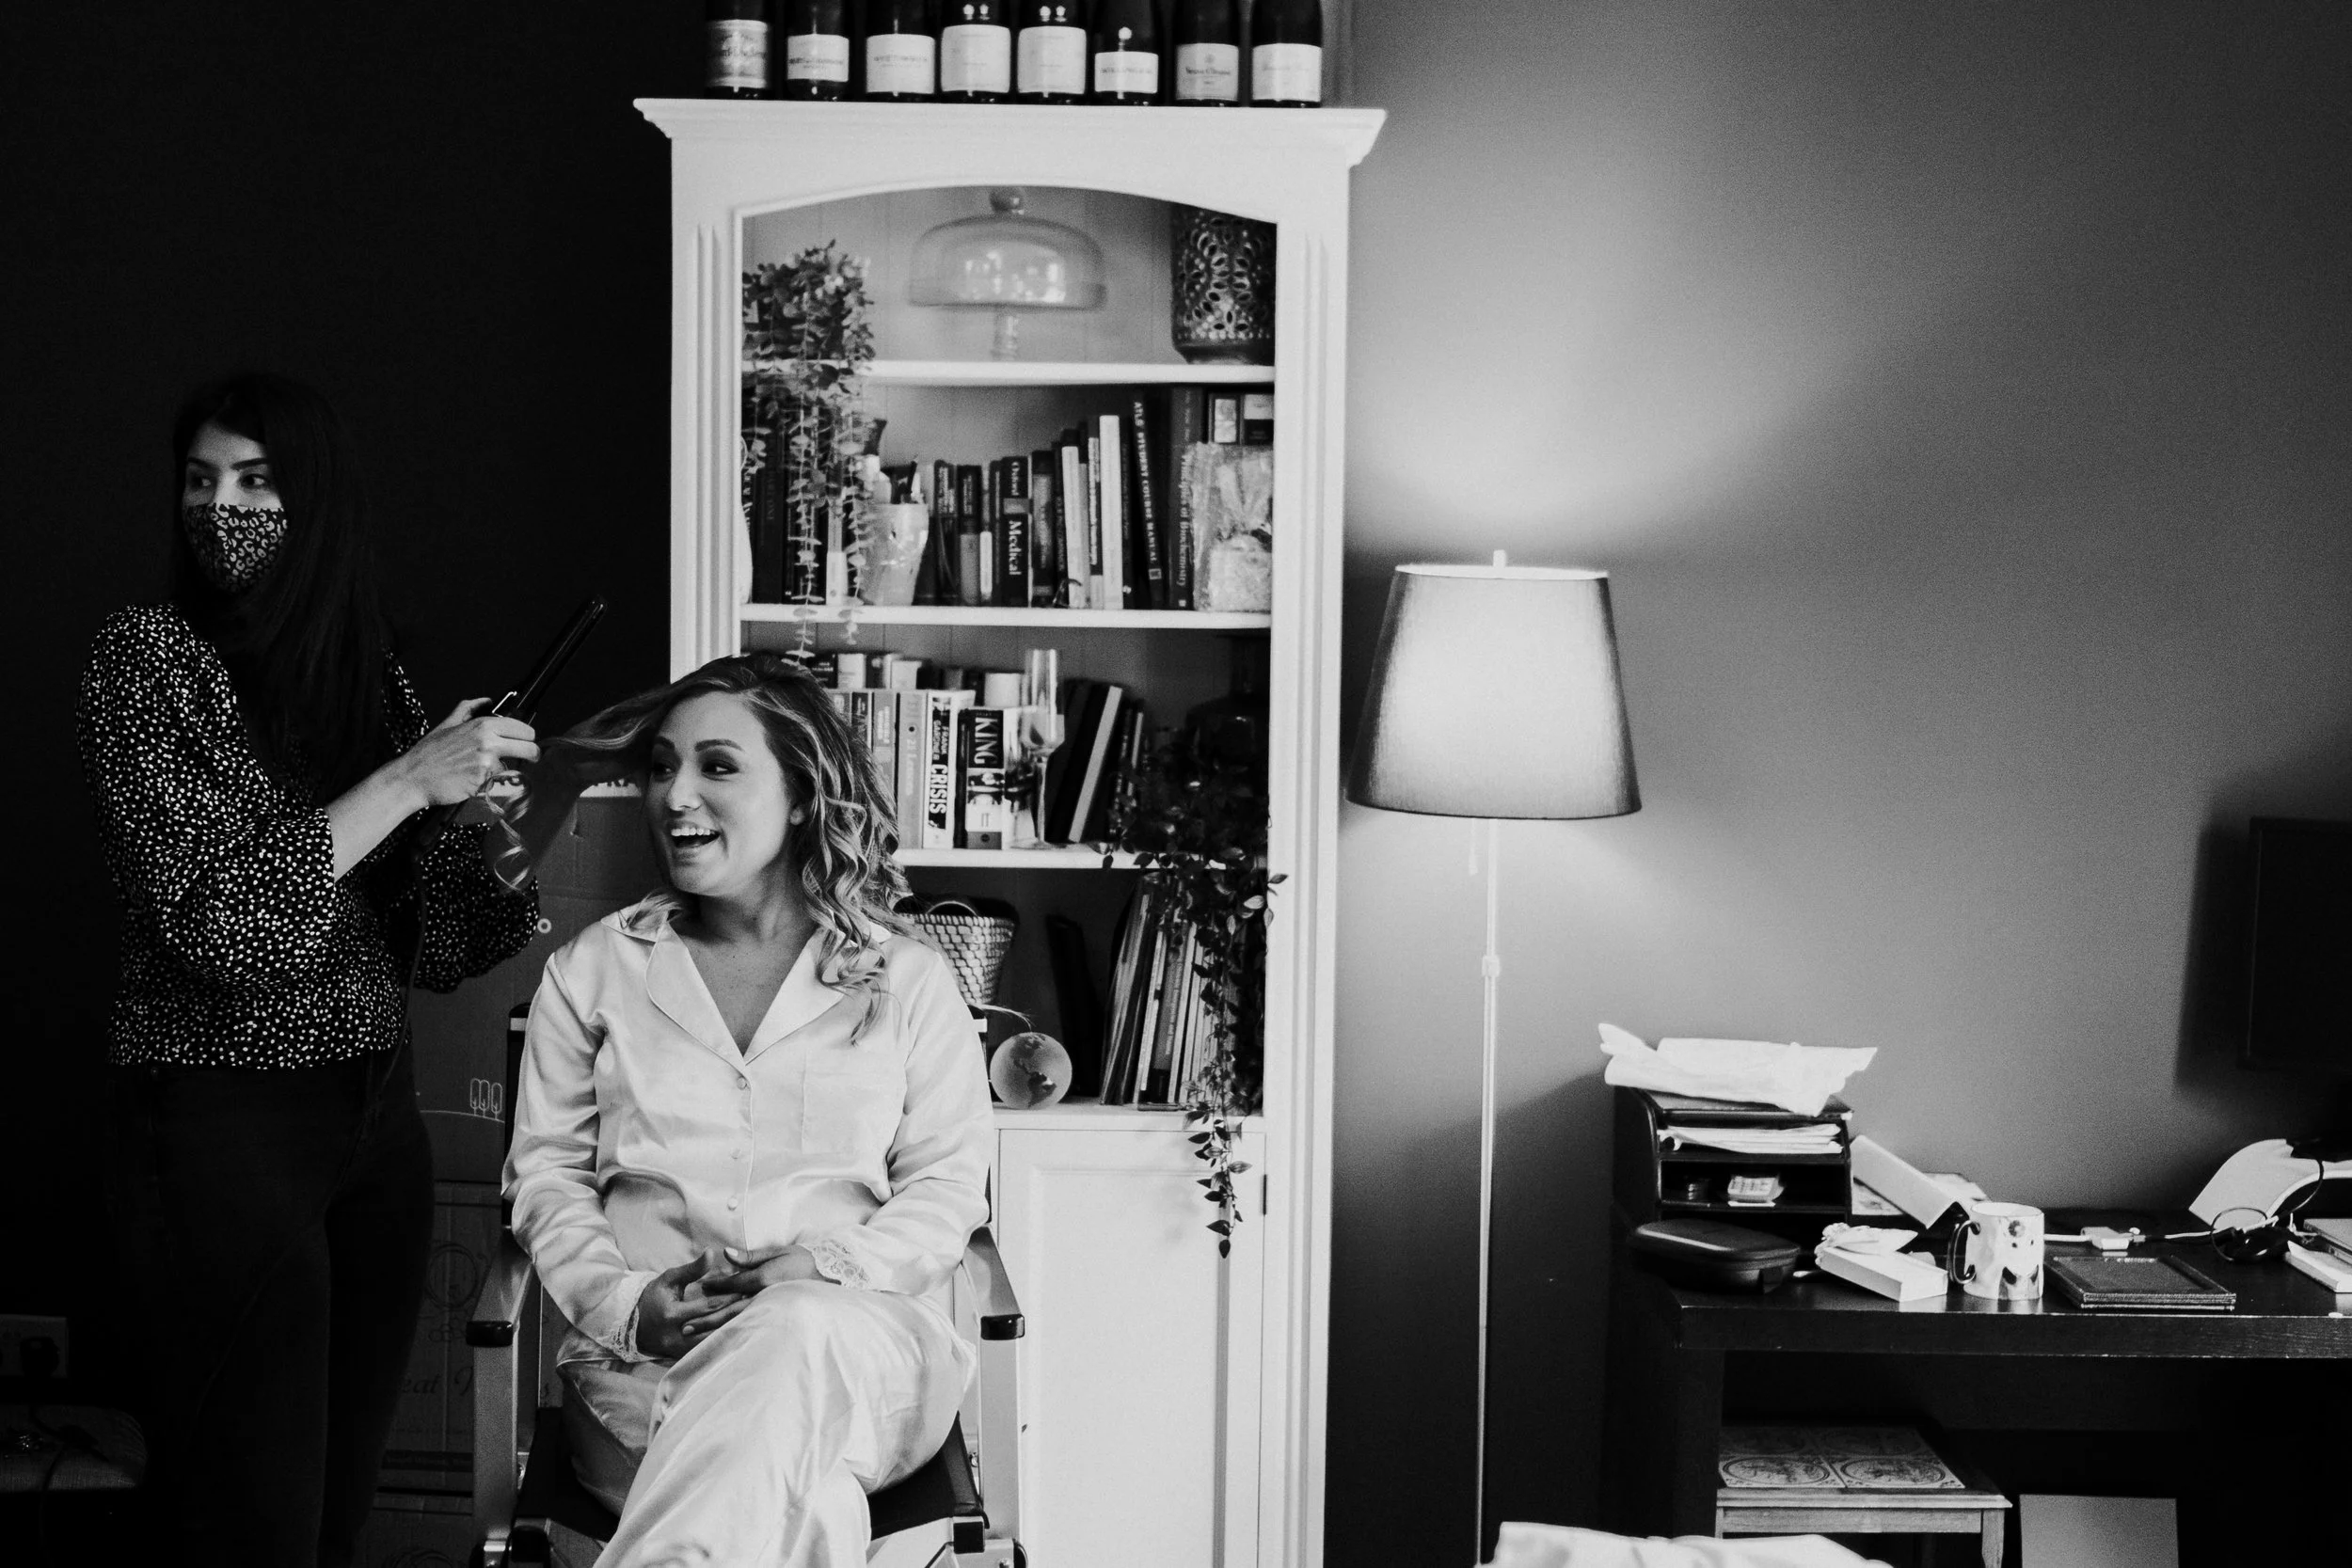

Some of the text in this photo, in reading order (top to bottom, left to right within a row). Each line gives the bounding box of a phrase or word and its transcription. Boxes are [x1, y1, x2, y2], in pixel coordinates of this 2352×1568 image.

[1136, 432, 1150, 477] STUDENT
[1010, 461, 1021, 497] Oxford
[1140, 480, 1153, 520] COURSE
[1008, 520, 1023, 576] Medical
[1145, 522, 1158, 563] MANUAL
[932, 720, 942, 761] GARDNER
[941, 726, 949, 754] FRANK
[973, 716, 999, 765] KING
[929, 764, 948, 815] CRISIS
